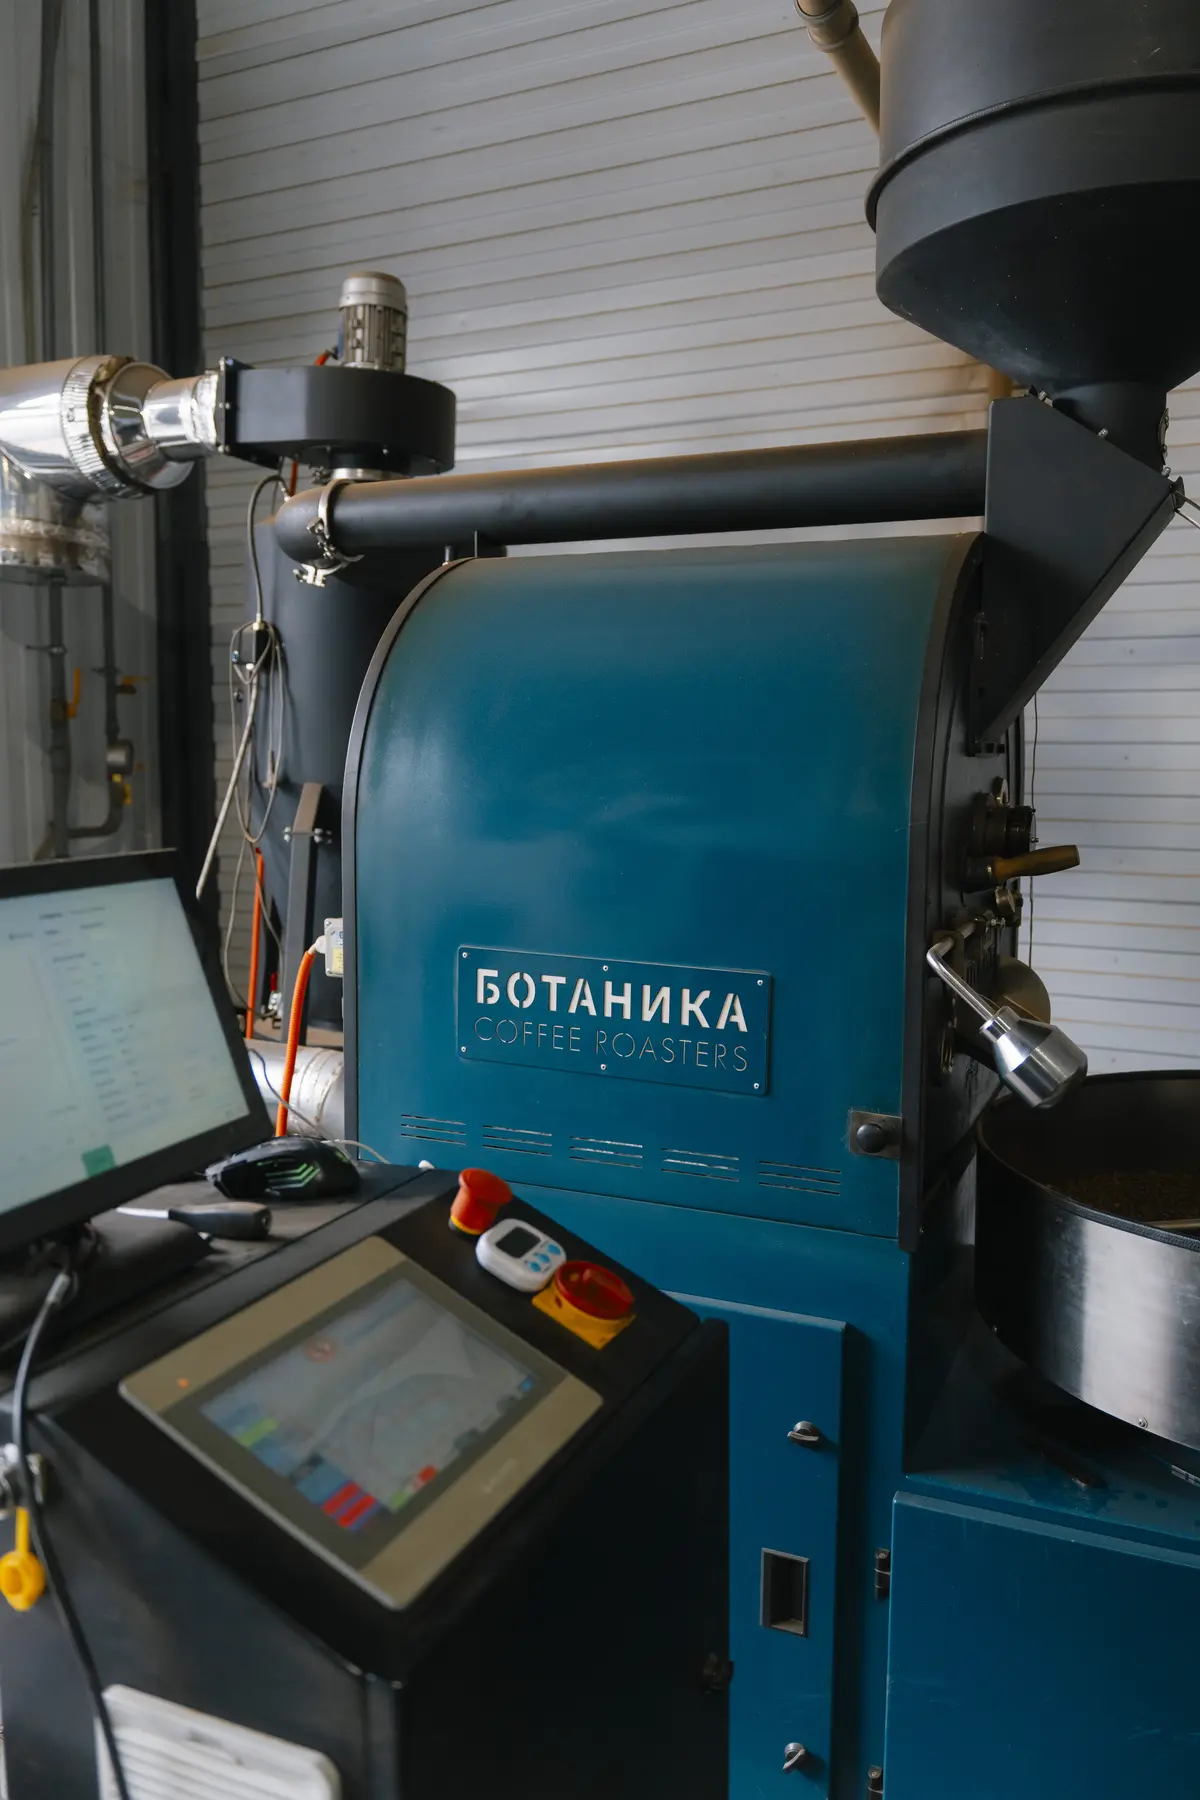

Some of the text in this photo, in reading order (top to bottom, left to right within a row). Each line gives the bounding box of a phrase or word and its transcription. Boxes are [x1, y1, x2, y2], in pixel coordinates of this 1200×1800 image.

[475, 968, 748, 1032] БОТАНИКА
[474, 1016, 748, 1072] COFFEE ROASTERS
